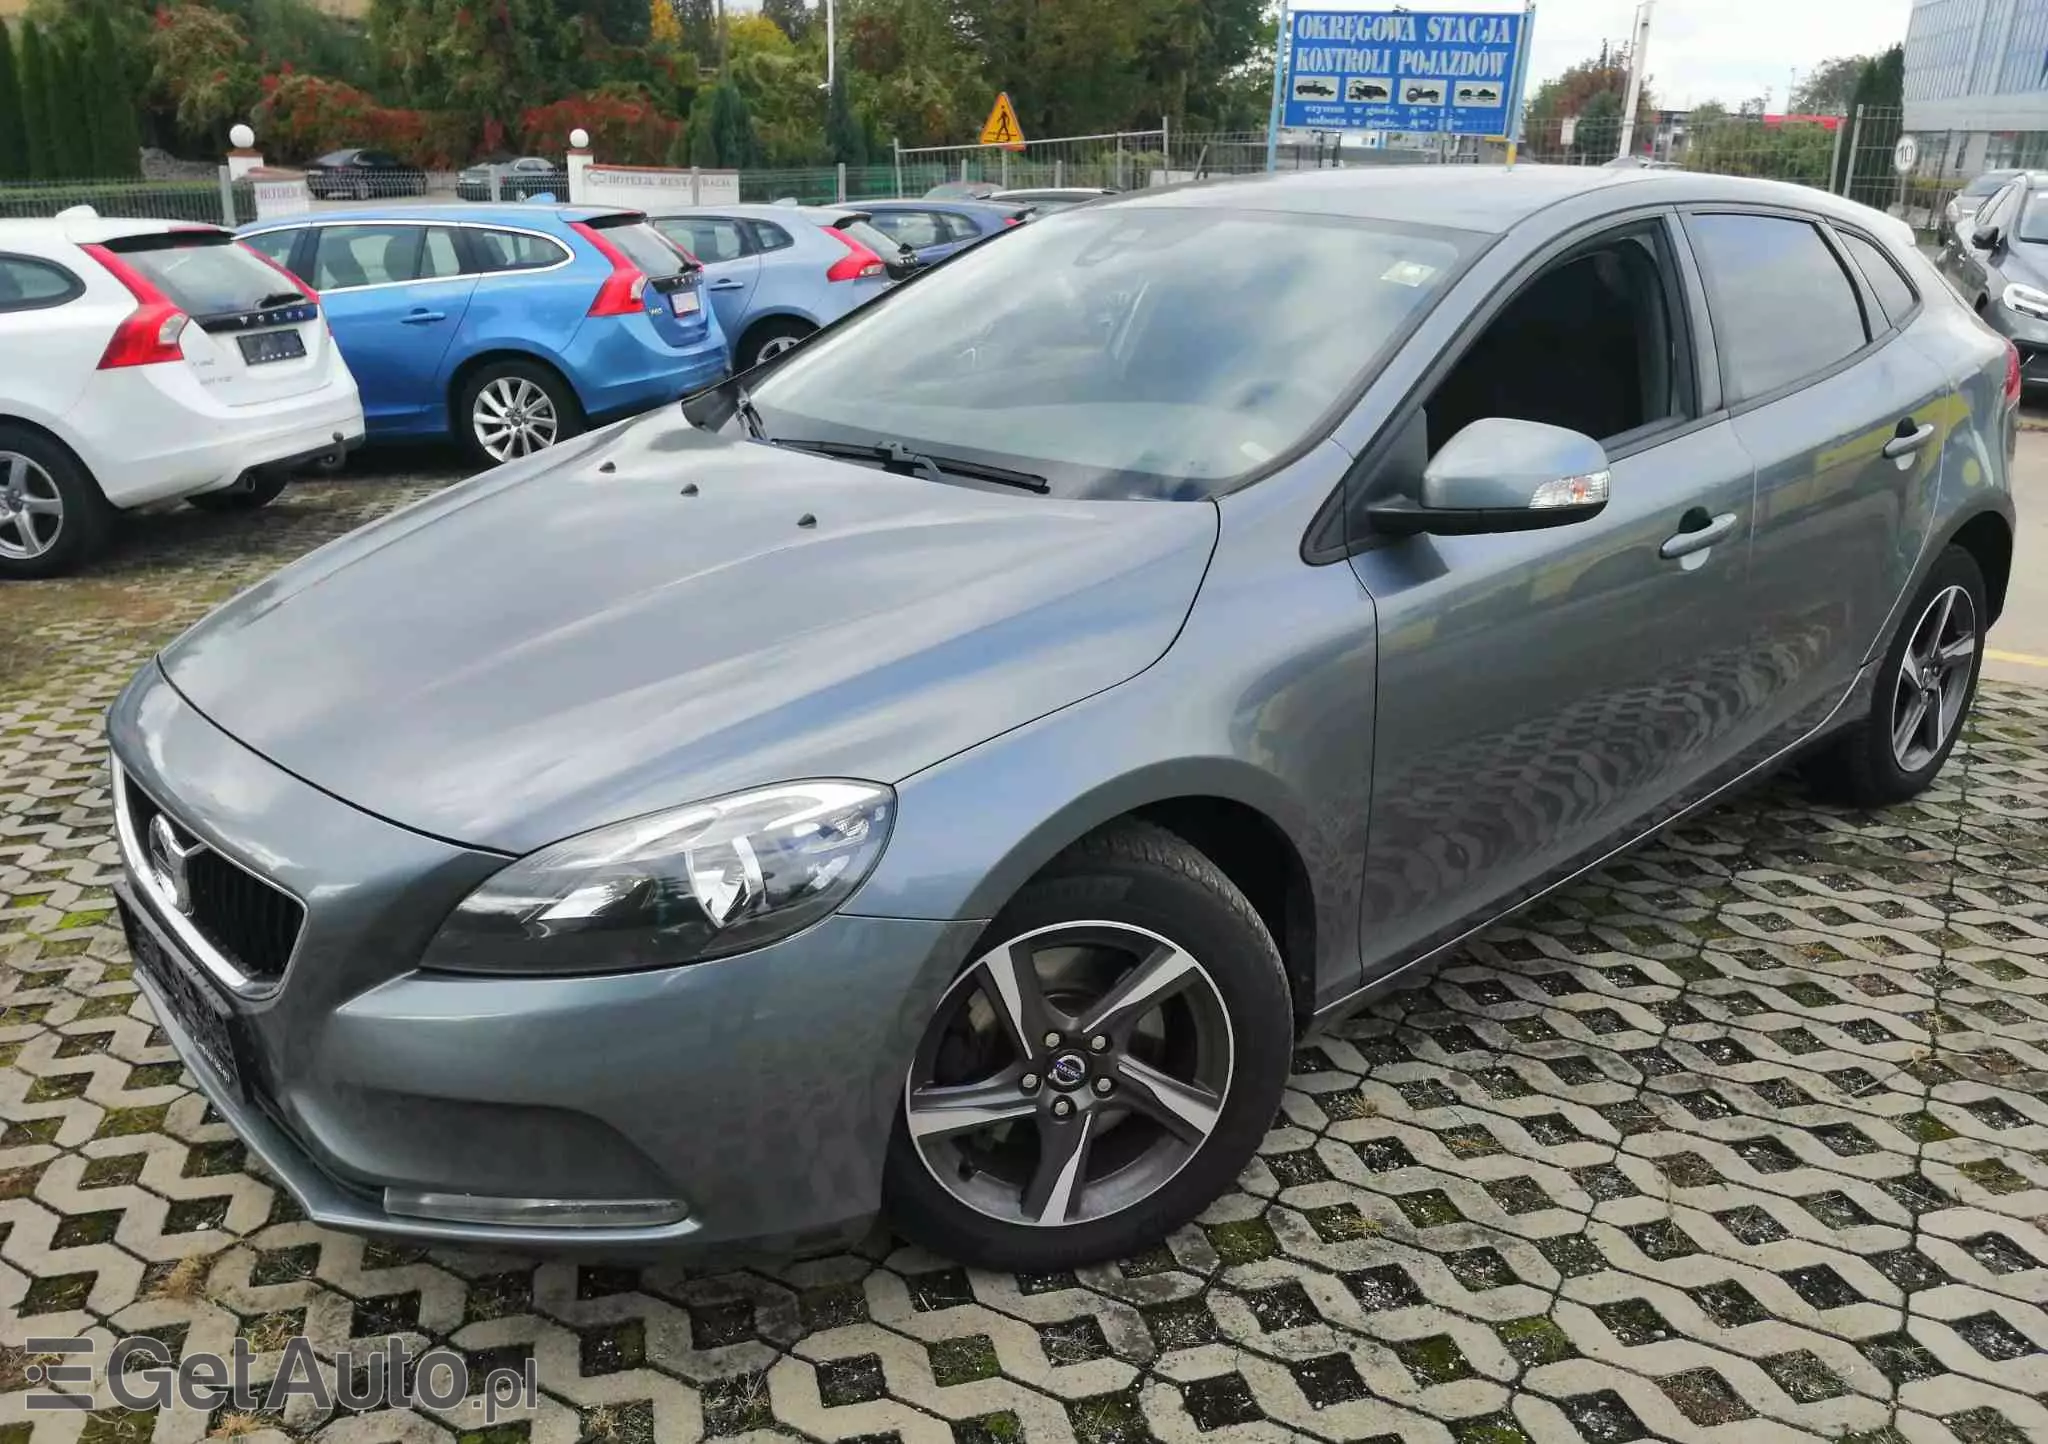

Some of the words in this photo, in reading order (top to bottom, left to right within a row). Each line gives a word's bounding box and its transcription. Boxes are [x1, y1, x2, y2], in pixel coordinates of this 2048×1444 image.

[1297, 14, 1417, 45] OKRĘGOWA
[1425, 15, 1512, 44] STACJA
[1295, 47, 1391, 74] KONTROLI
[1397, 46, 1509, 77] POJAZDÓW
